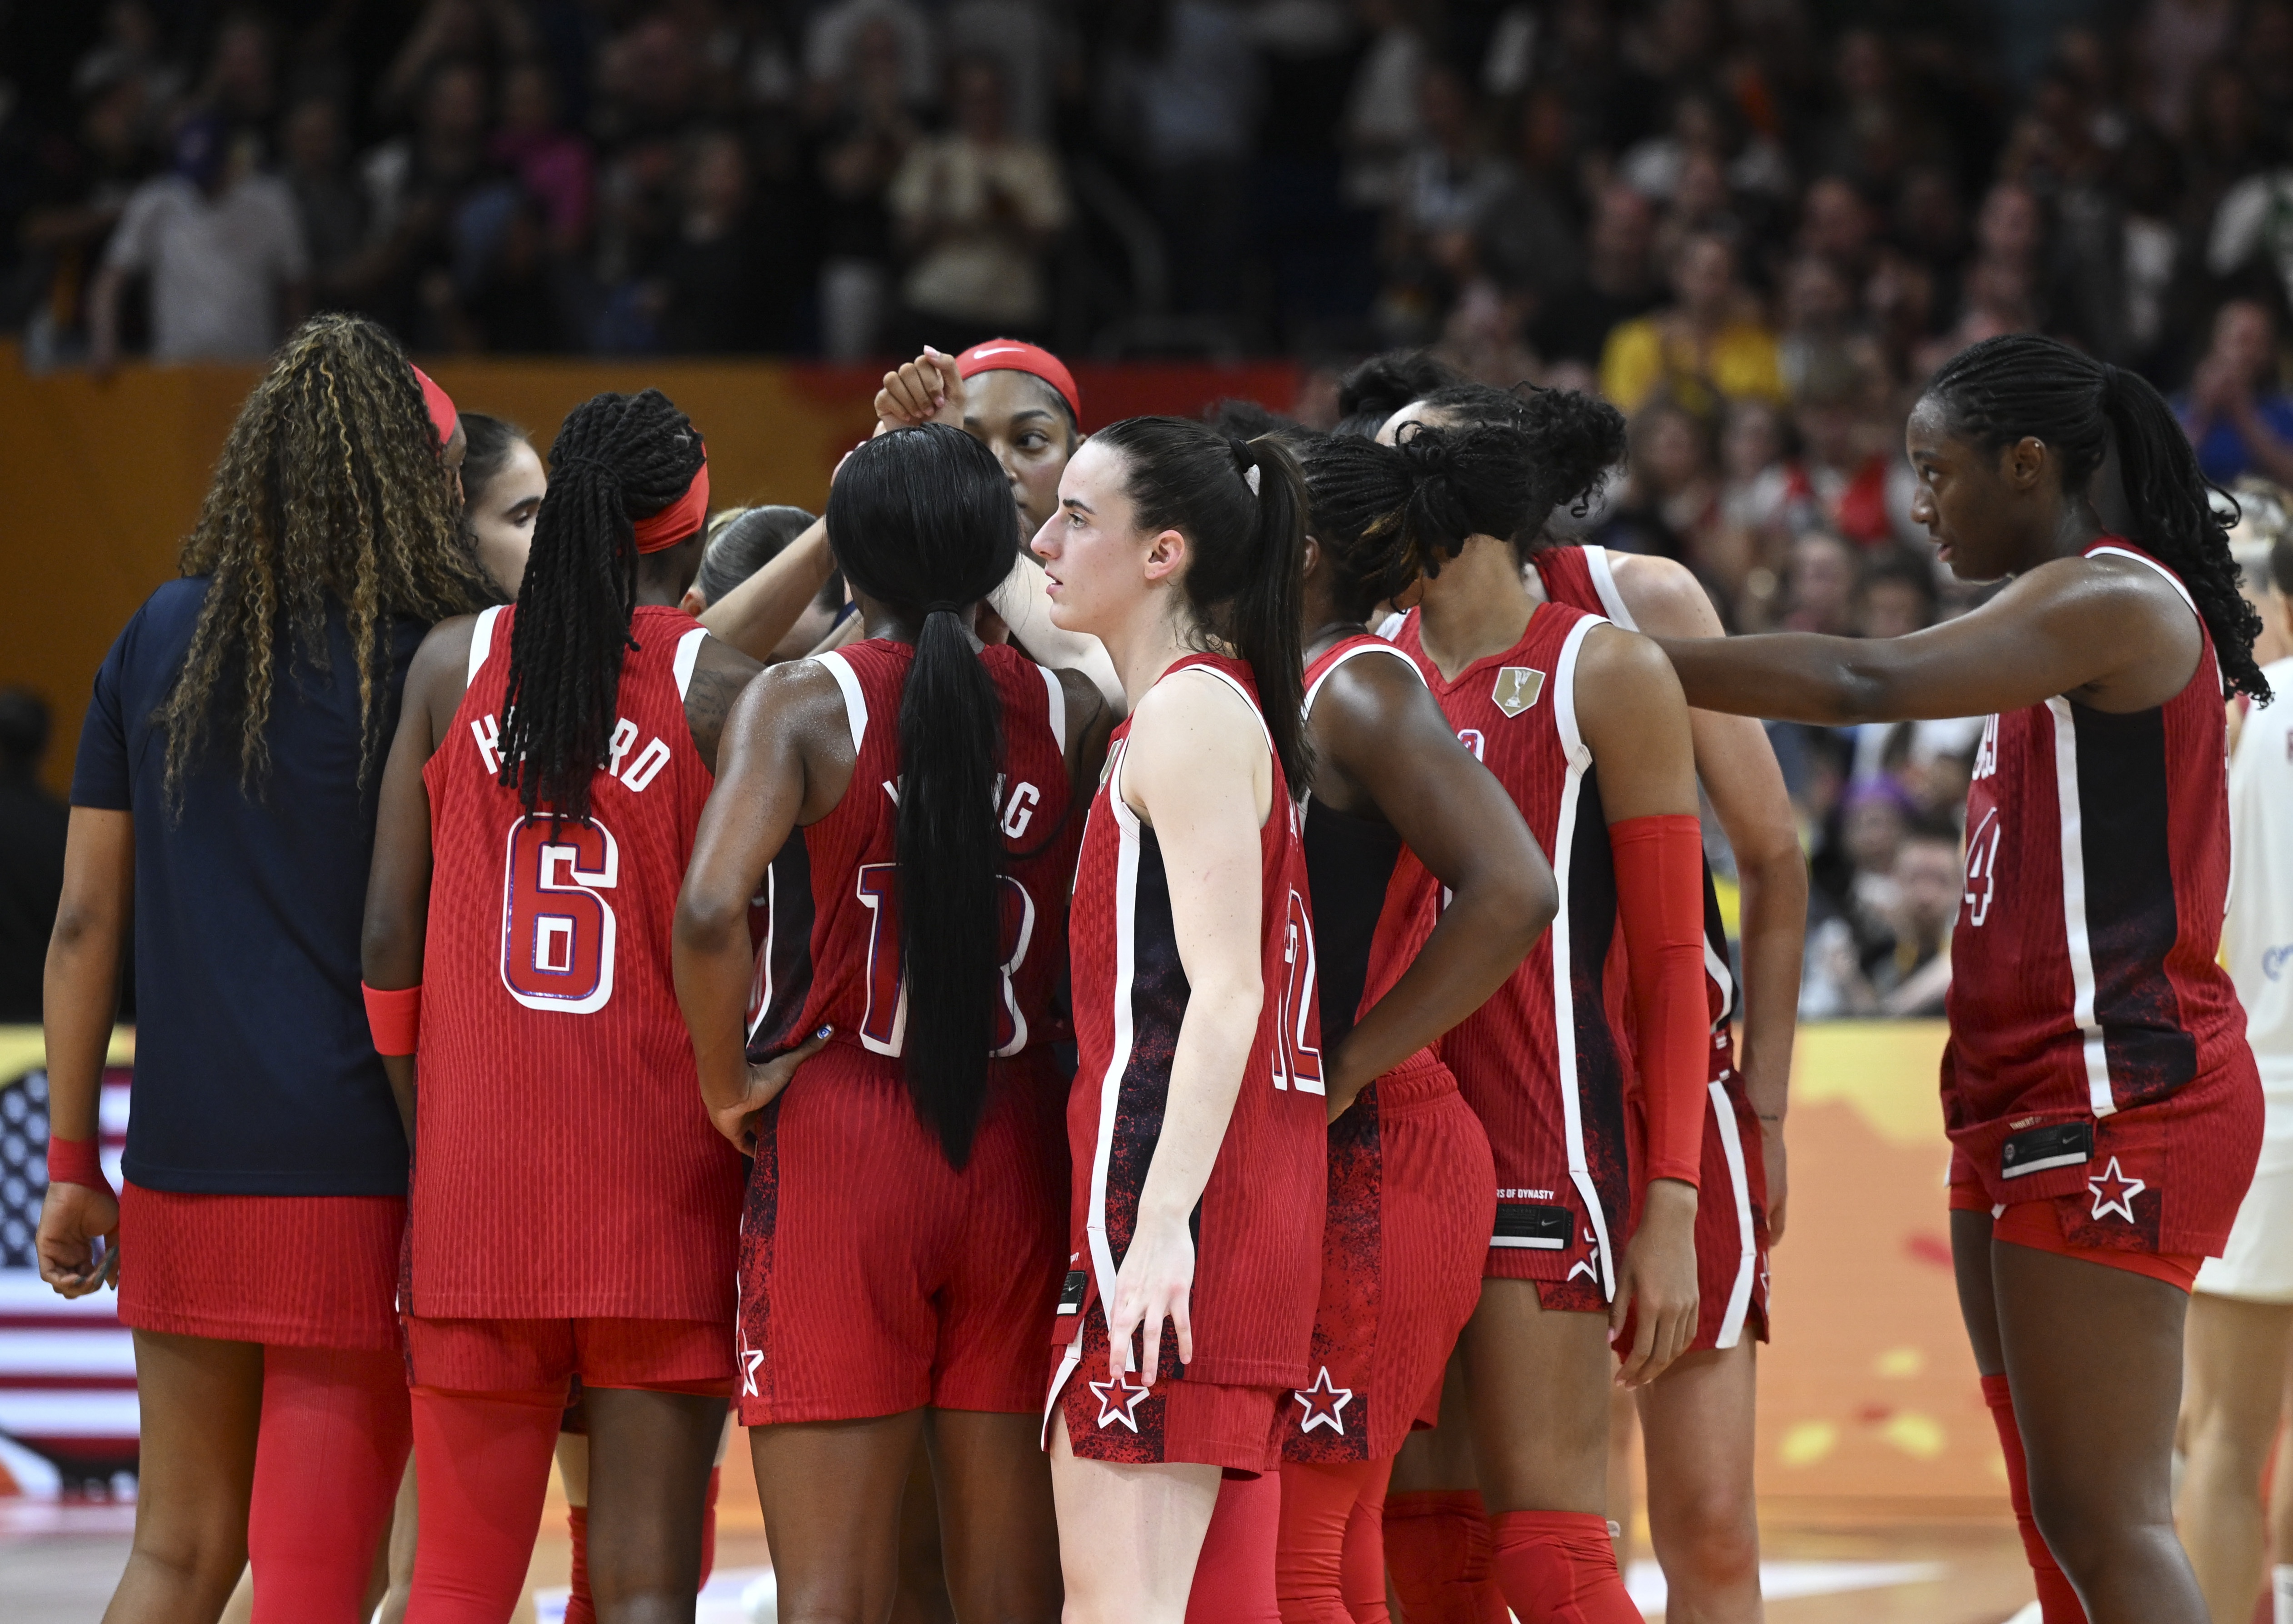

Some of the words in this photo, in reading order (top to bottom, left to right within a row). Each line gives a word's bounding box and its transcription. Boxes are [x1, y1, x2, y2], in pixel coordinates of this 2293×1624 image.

[470, 706, 670, 792] HRD
[500, 812, 619, 1014] 6
[1506, 1189, 1516, 1199] OF
[1517, 1189, 1554, 1200] DYNASTY
